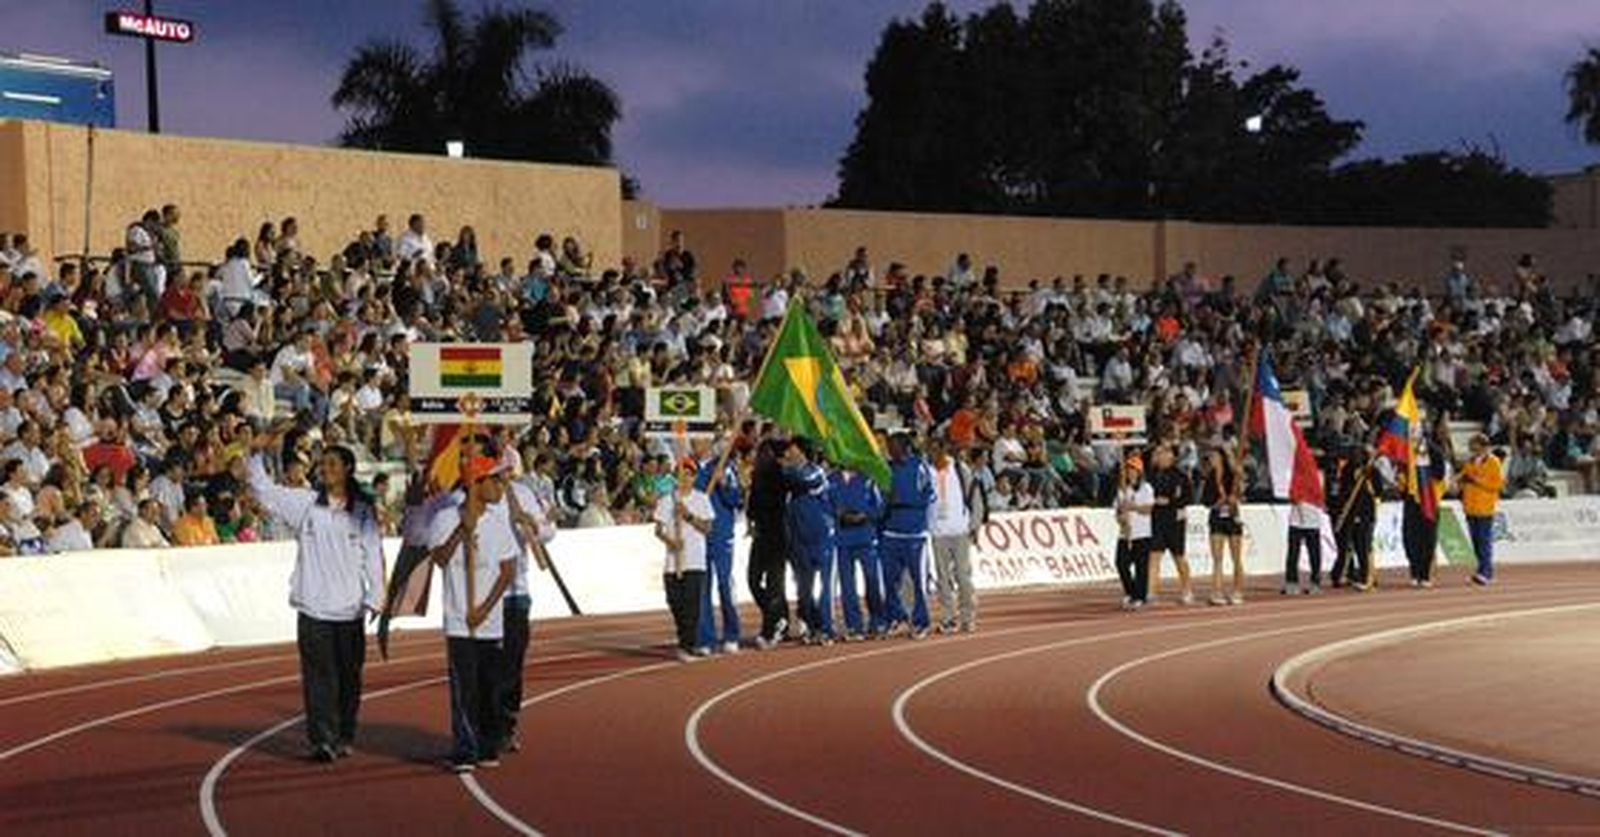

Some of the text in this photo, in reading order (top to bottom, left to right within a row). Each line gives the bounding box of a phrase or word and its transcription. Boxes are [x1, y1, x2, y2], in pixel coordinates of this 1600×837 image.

[119, 16, 190, 39] McAUTO
[977, 515, 1099, 551] OYOTA
[1045, 552, 1115, 579] BAHIA
